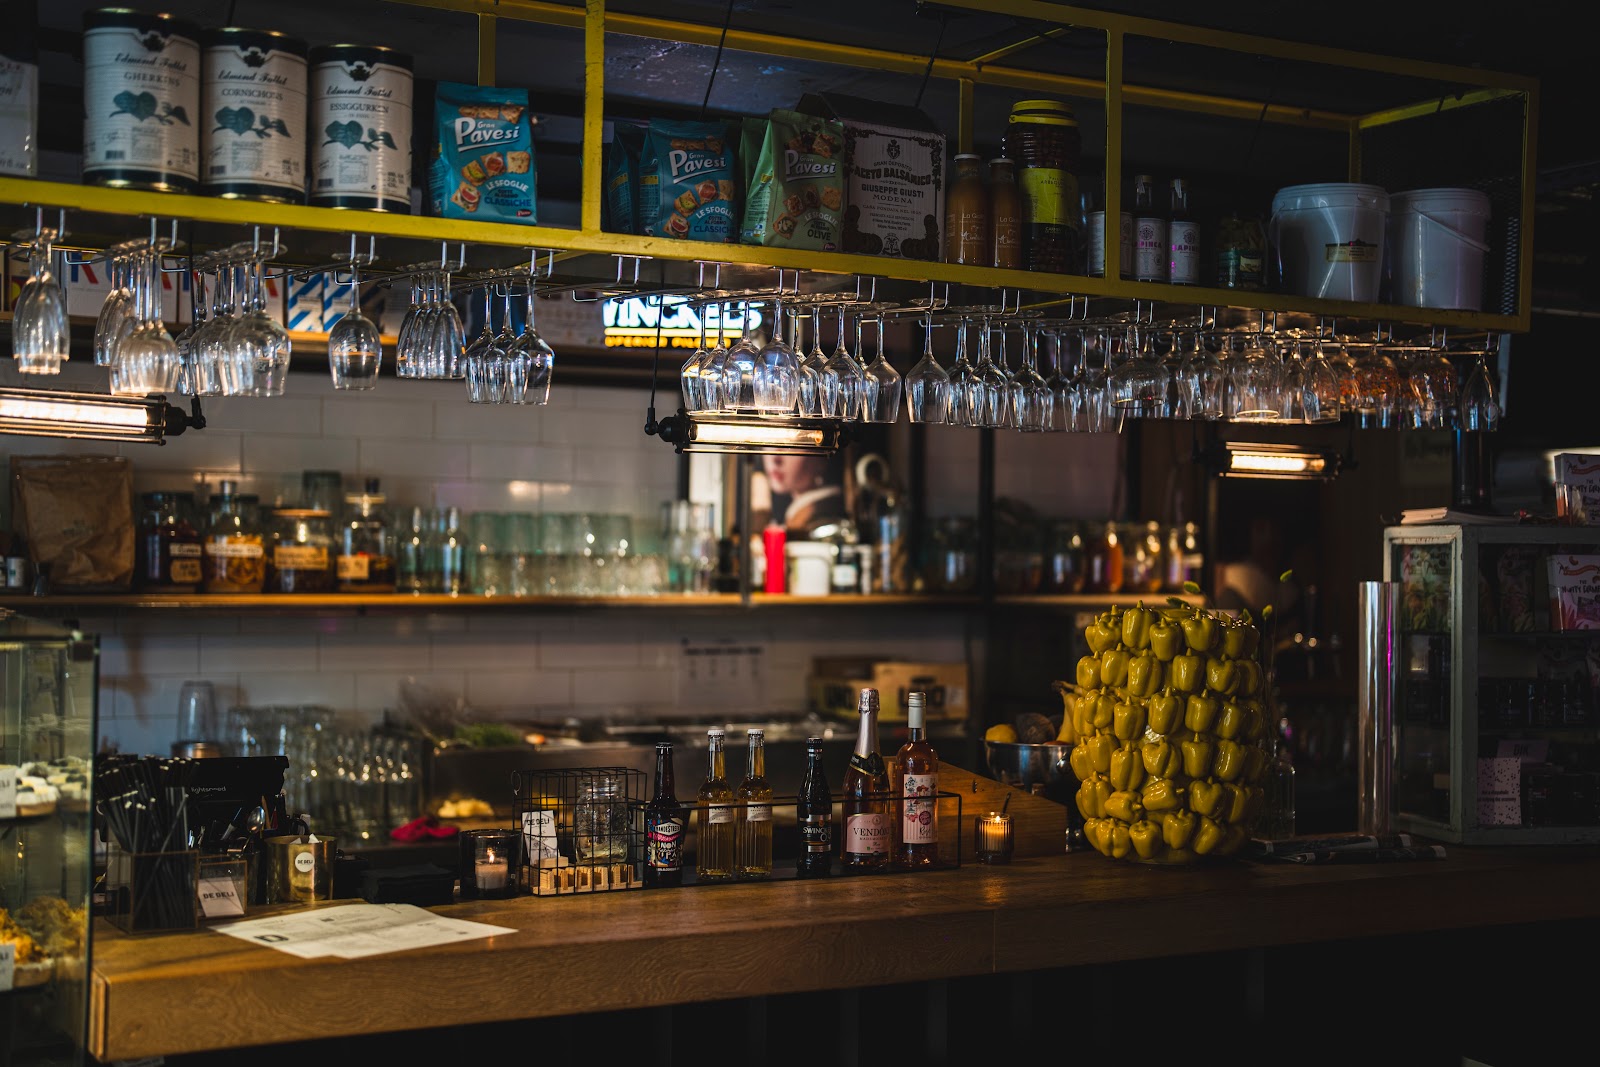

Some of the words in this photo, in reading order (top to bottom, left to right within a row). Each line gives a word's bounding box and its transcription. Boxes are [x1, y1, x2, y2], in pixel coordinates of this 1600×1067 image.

[124, 72, 180, 87] GHERKINS
[222, 88, 283, 101] CORNICHONS
[329, 103, 389, 113] ESSIGGURKEN
[454, 117, 520, 145] Pavesi
[477, 121, 495, 129] Gran
[669, 149, 726, 177] Pavesi
[785, 149, 836, 176] Pavesi
[854, 165, 881, 179] ACETO
[883, 167, 931, 185] BALSAMICO
[486, 182, 495, 190] LE
[495, 179, 529, 192] SFOGLIE
[861, 183, 898, 195] GIUSEPPE
[899, 188, 924, 198] GIUSTI
[484, 197, 532, 207] CLASSICHE
[872, 195, 912, 204] MODENA
[695, 211, 705, 219] LE
[807, 229, 831, 241] OLIVE
[216, 891, 234, 899] DELI
